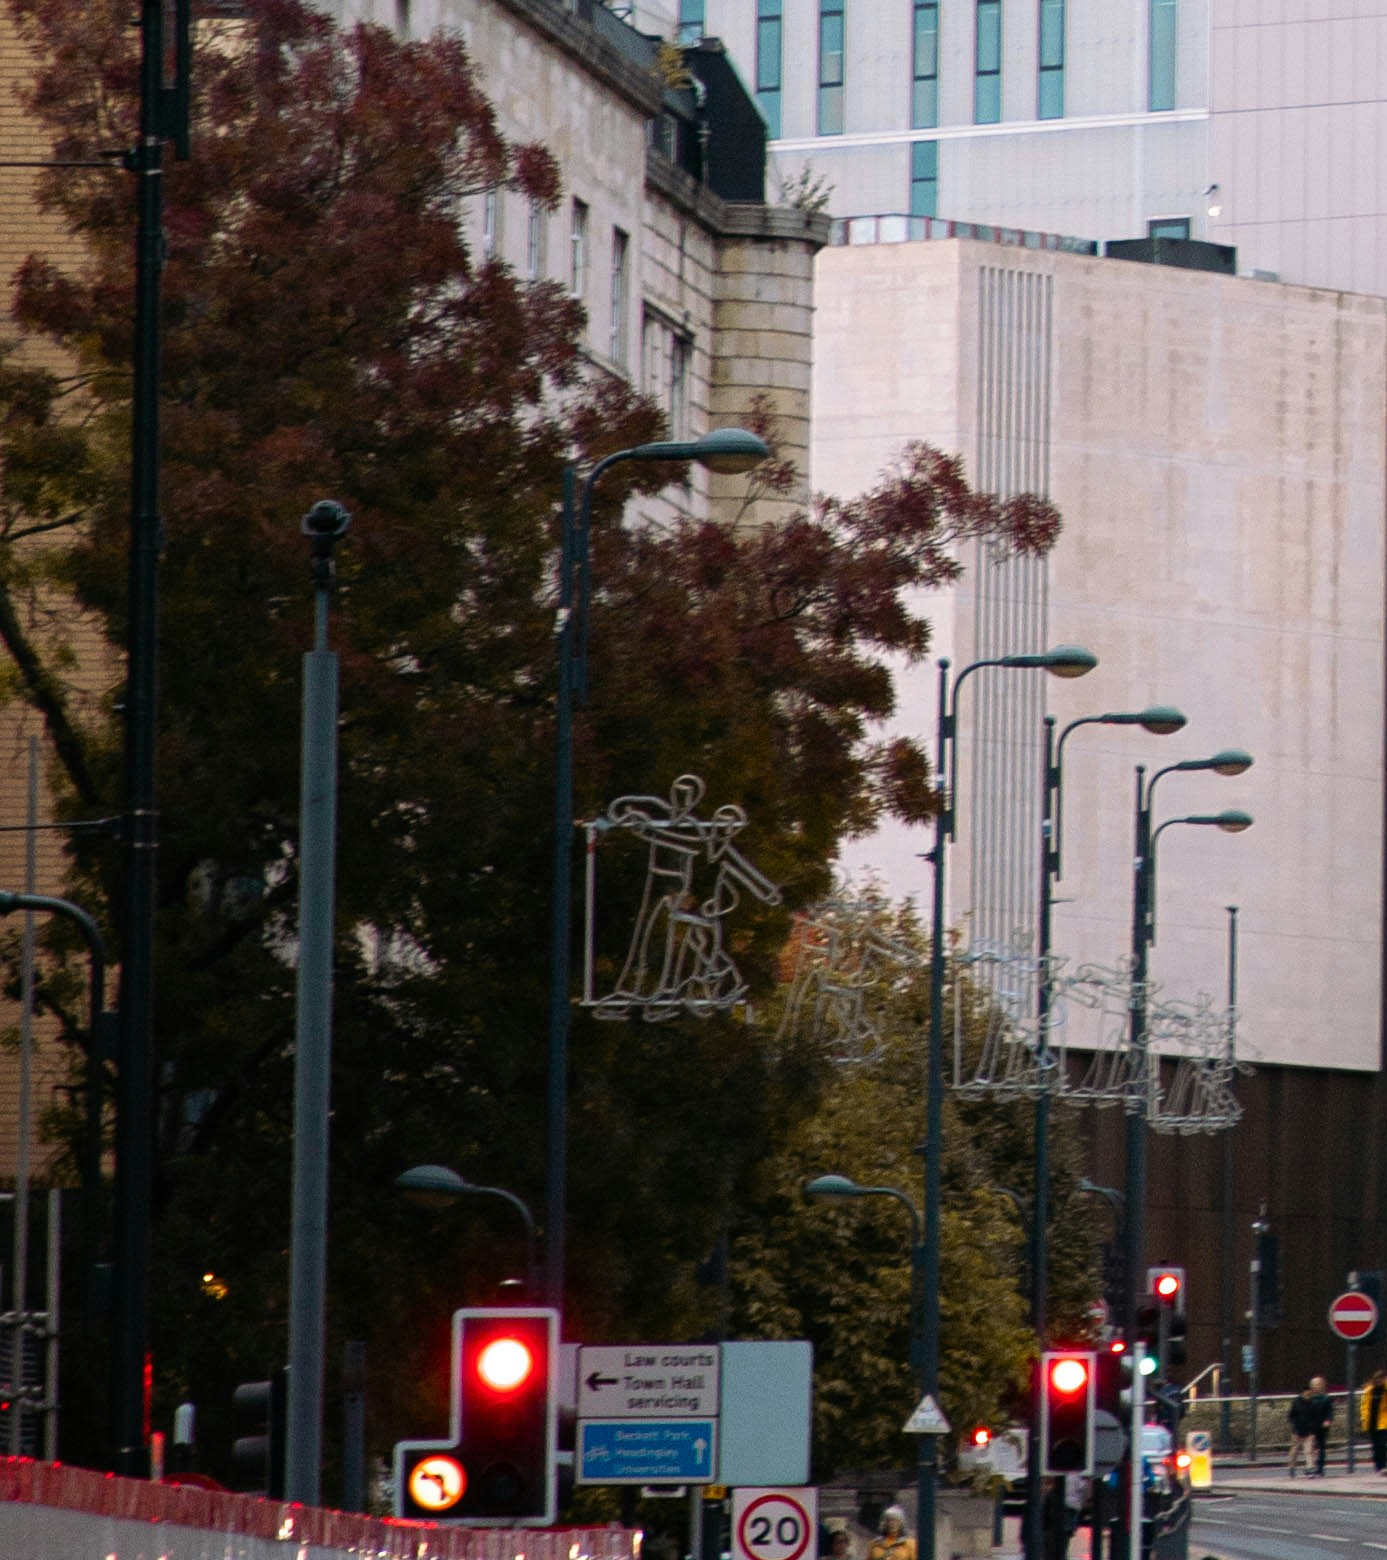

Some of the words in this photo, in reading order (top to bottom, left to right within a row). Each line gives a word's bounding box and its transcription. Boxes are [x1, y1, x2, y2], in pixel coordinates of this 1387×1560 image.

[624, 1353, 656, 1367] Law
[623, 1376, 666, 1390] Town
[672, 1376, 706, 1390] Hall
[627, 1396, 699, 1411] servicing
[750, 1517, 799, 1546] 20
